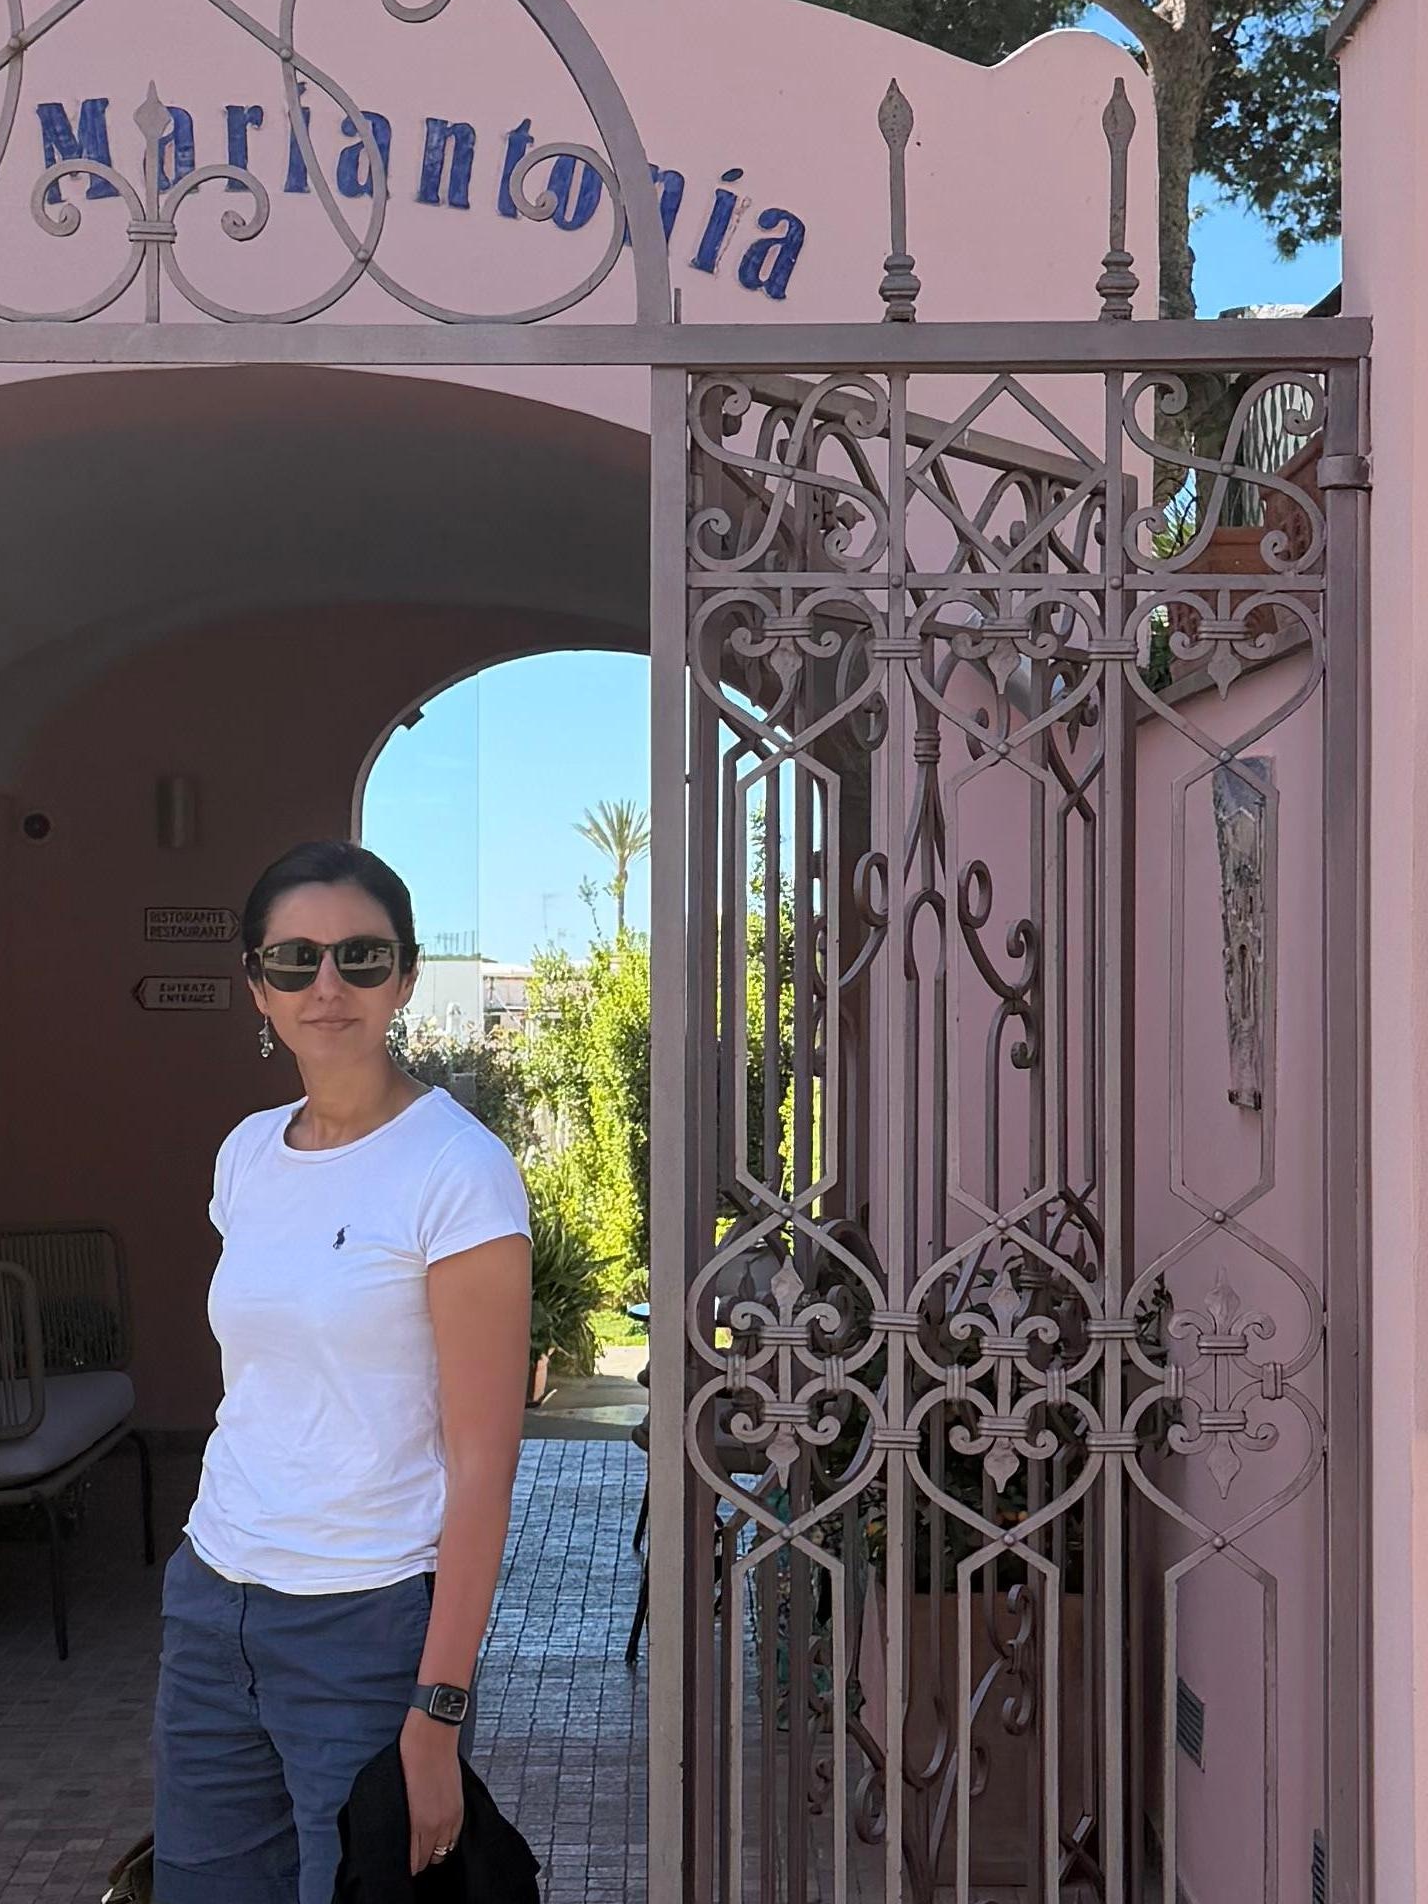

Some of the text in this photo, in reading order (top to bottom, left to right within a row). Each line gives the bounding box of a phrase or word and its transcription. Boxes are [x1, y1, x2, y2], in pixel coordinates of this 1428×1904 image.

[150, 911, 226, 924] RISTORANTE
[150, 925, 226, 938] RESTAURANT
[159, 983, 216, 993] ENTRATA
[159, 994, 215, 1004] ENTRANCE
